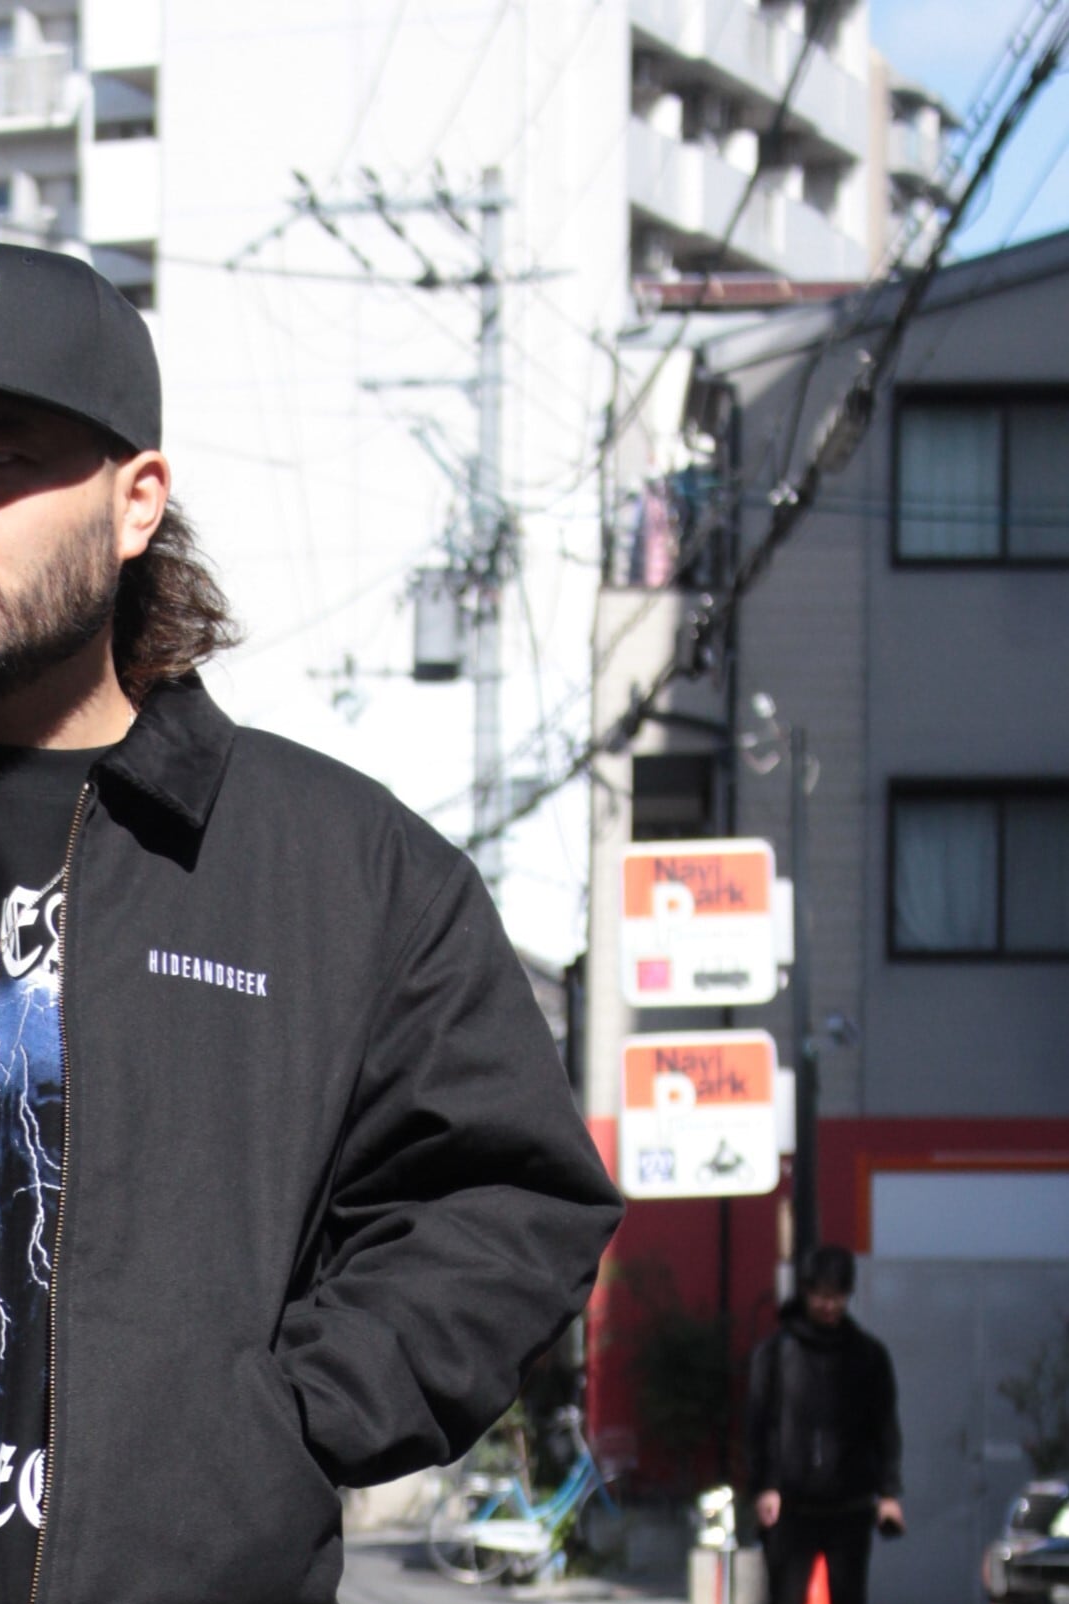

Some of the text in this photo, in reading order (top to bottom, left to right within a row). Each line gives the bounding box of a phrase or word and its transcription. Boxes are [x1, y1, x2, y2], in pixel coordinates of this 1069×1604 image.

[654, 857, 722, 882] Navi
[149, 949, 267, 997] HIDEANDSEEK
[655, 1046, 723, 1073] Navi
